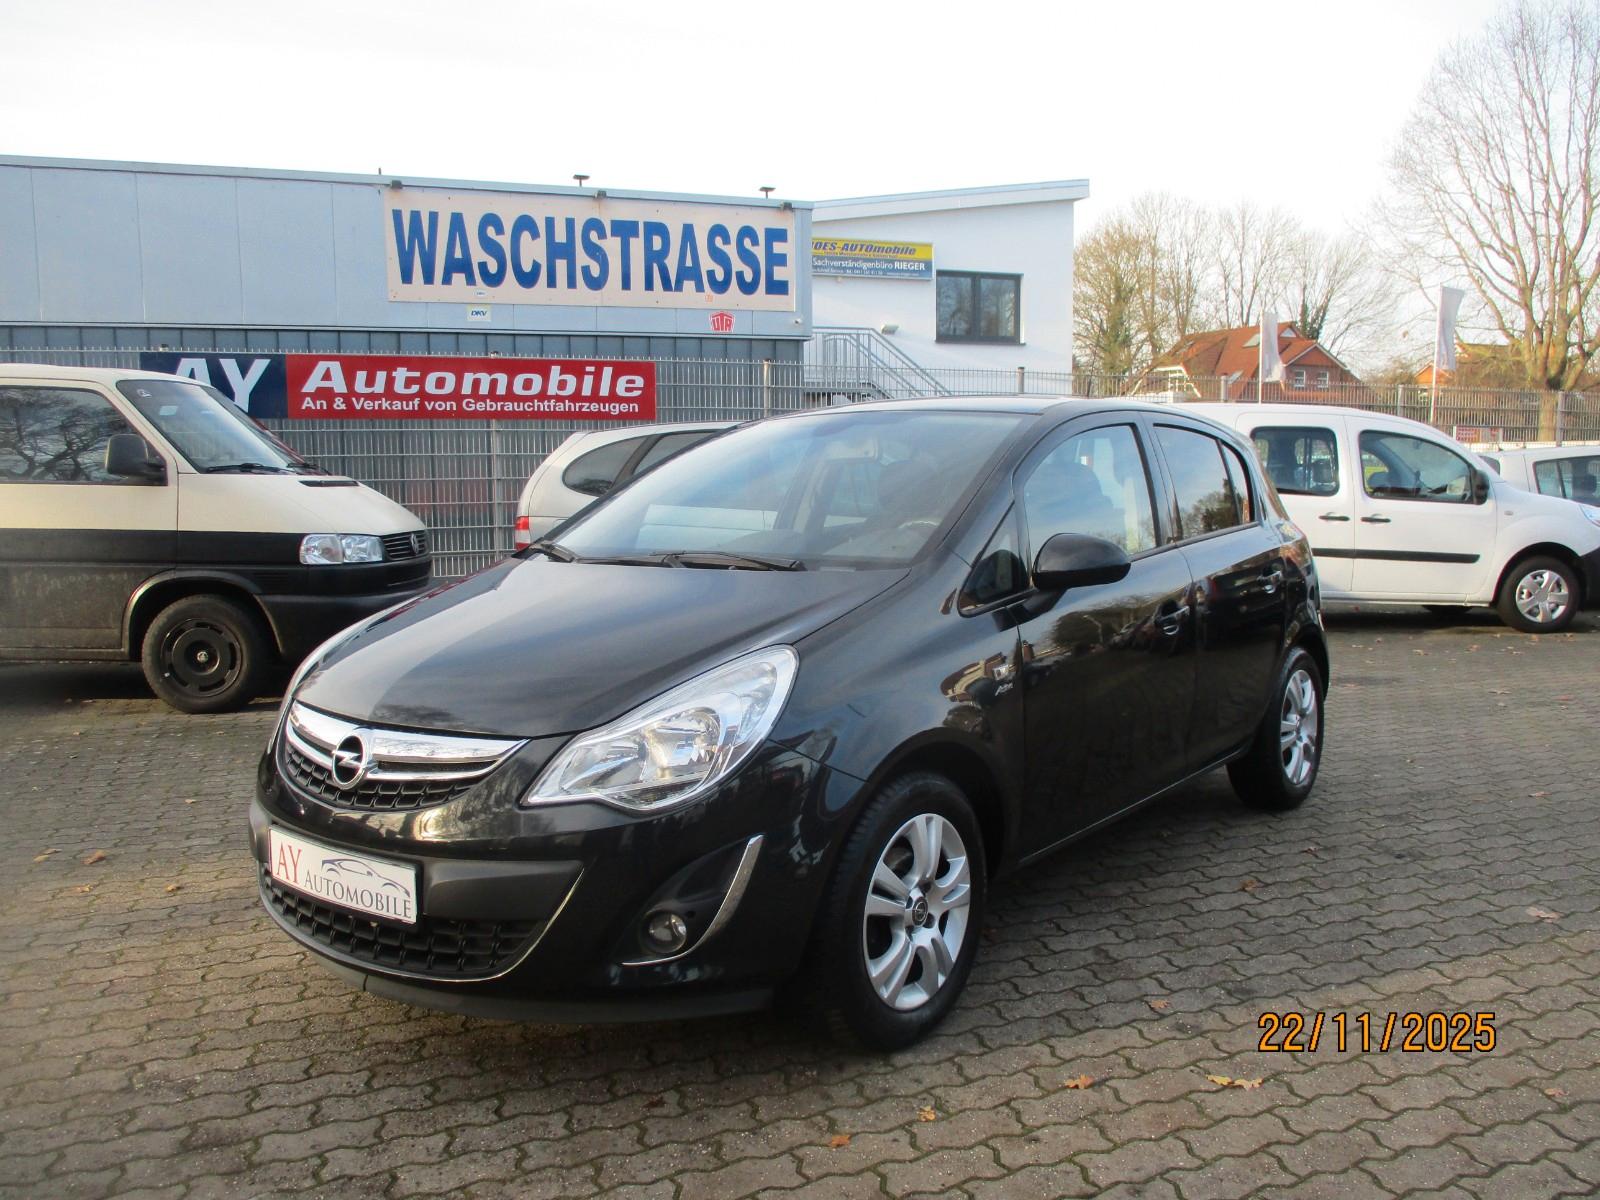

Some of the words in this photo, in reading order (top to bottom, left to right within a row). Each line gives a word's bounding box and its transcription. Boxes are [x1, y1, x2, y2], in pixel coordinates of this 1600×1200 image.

[391, 208, 790, 296] WASCHSTRASSE
[812, 241, 916, 255] OES-AUTOmobile
[812, 256, 894, 271] Sachverständigenbüro
[894, 261, 926, 272] RIEGER
[301, 360, 645, 397] Automobile
[301, 397, 327, 410] An
[333, 397, 347, 410] &
[352, 397, 421, 411] Verkauf
[425, 401, 457, 411] von
[462, 399, 639, 415] Gebrauchtfahrzeugen
[277, 841, 302, 886] AY
[304, 870, 412, 919] AUTOMOBILE
